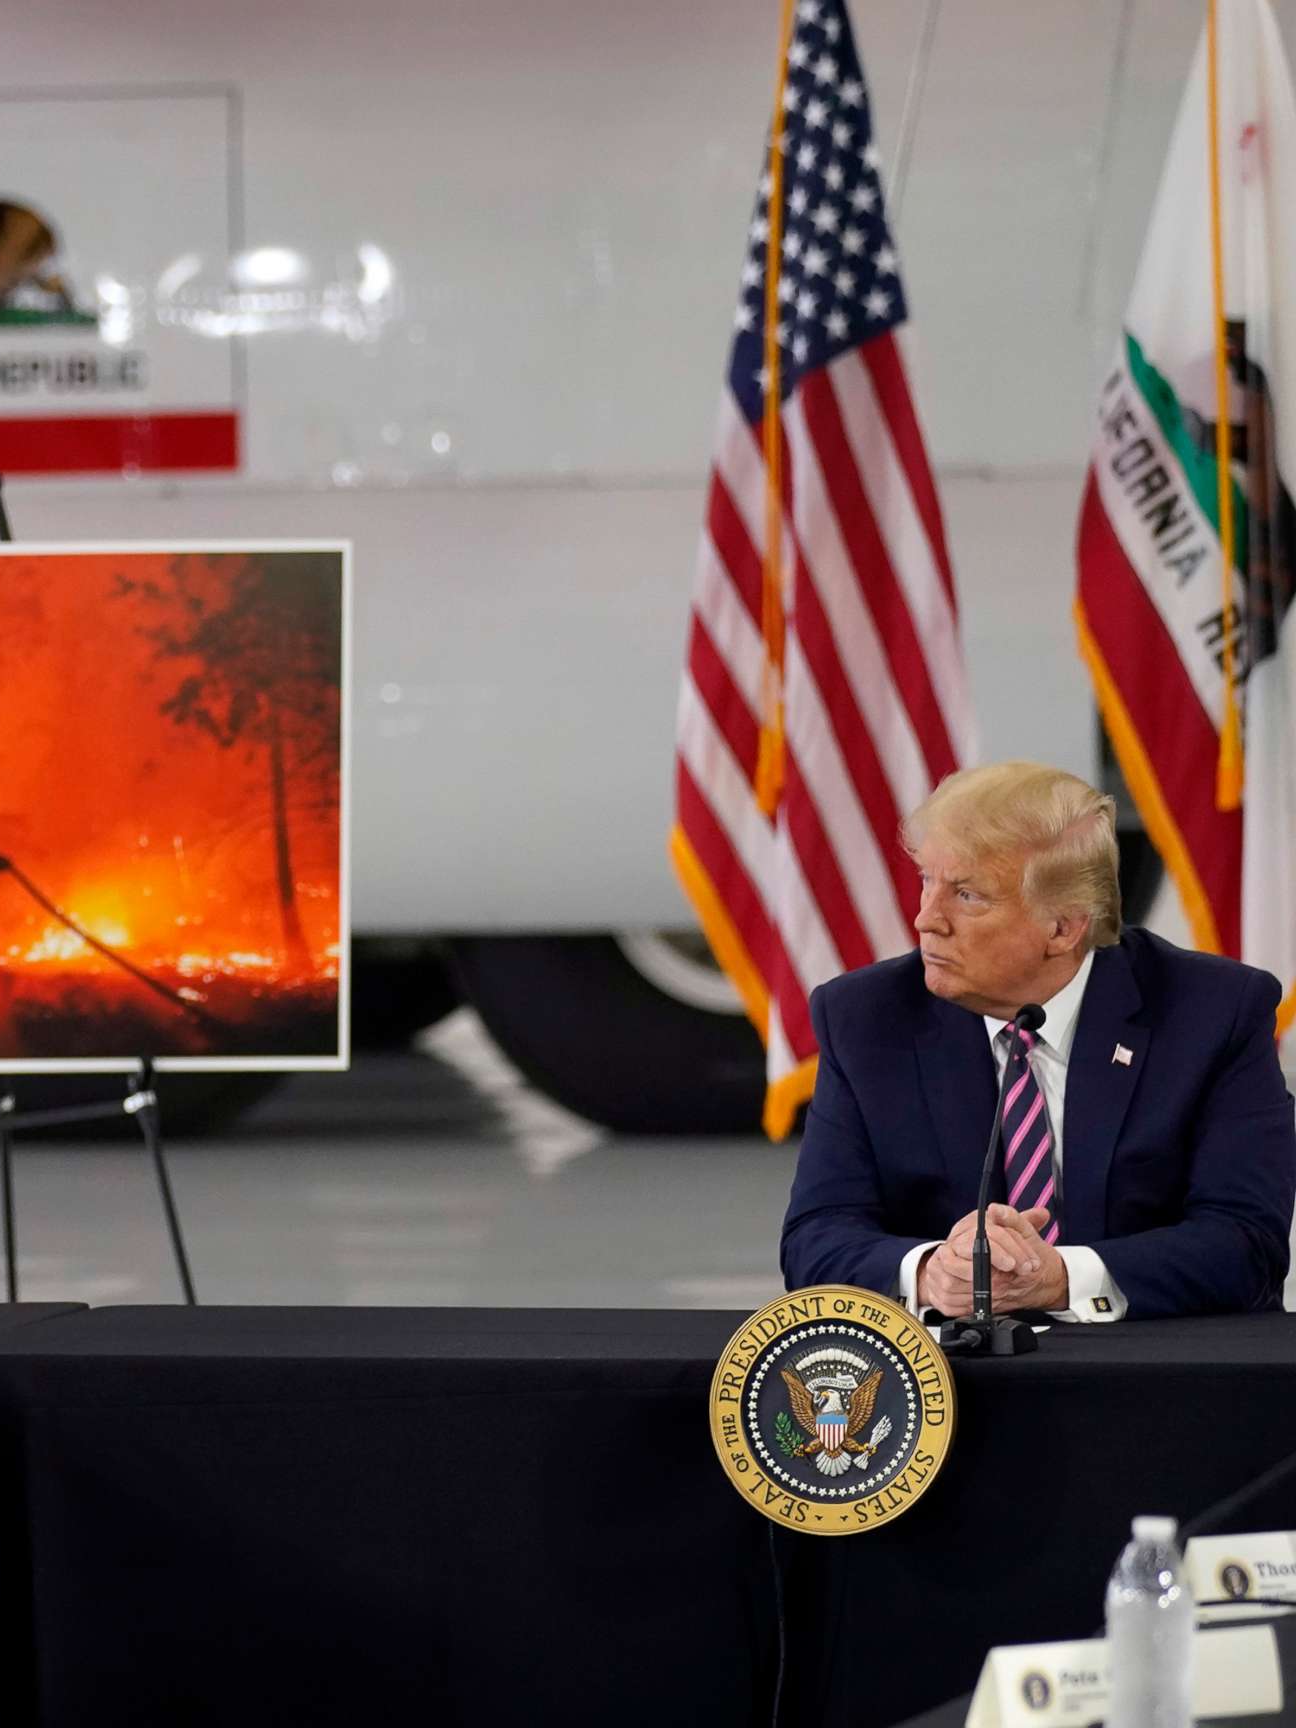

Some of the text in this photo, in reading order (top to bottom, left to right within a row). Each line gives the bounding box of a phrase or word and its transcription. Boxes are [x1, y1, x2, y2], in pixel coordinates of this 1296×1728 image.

[719, 1296, 945, 1523] SEAL OF THE PRESIDENT OF THE UNITED STATES
